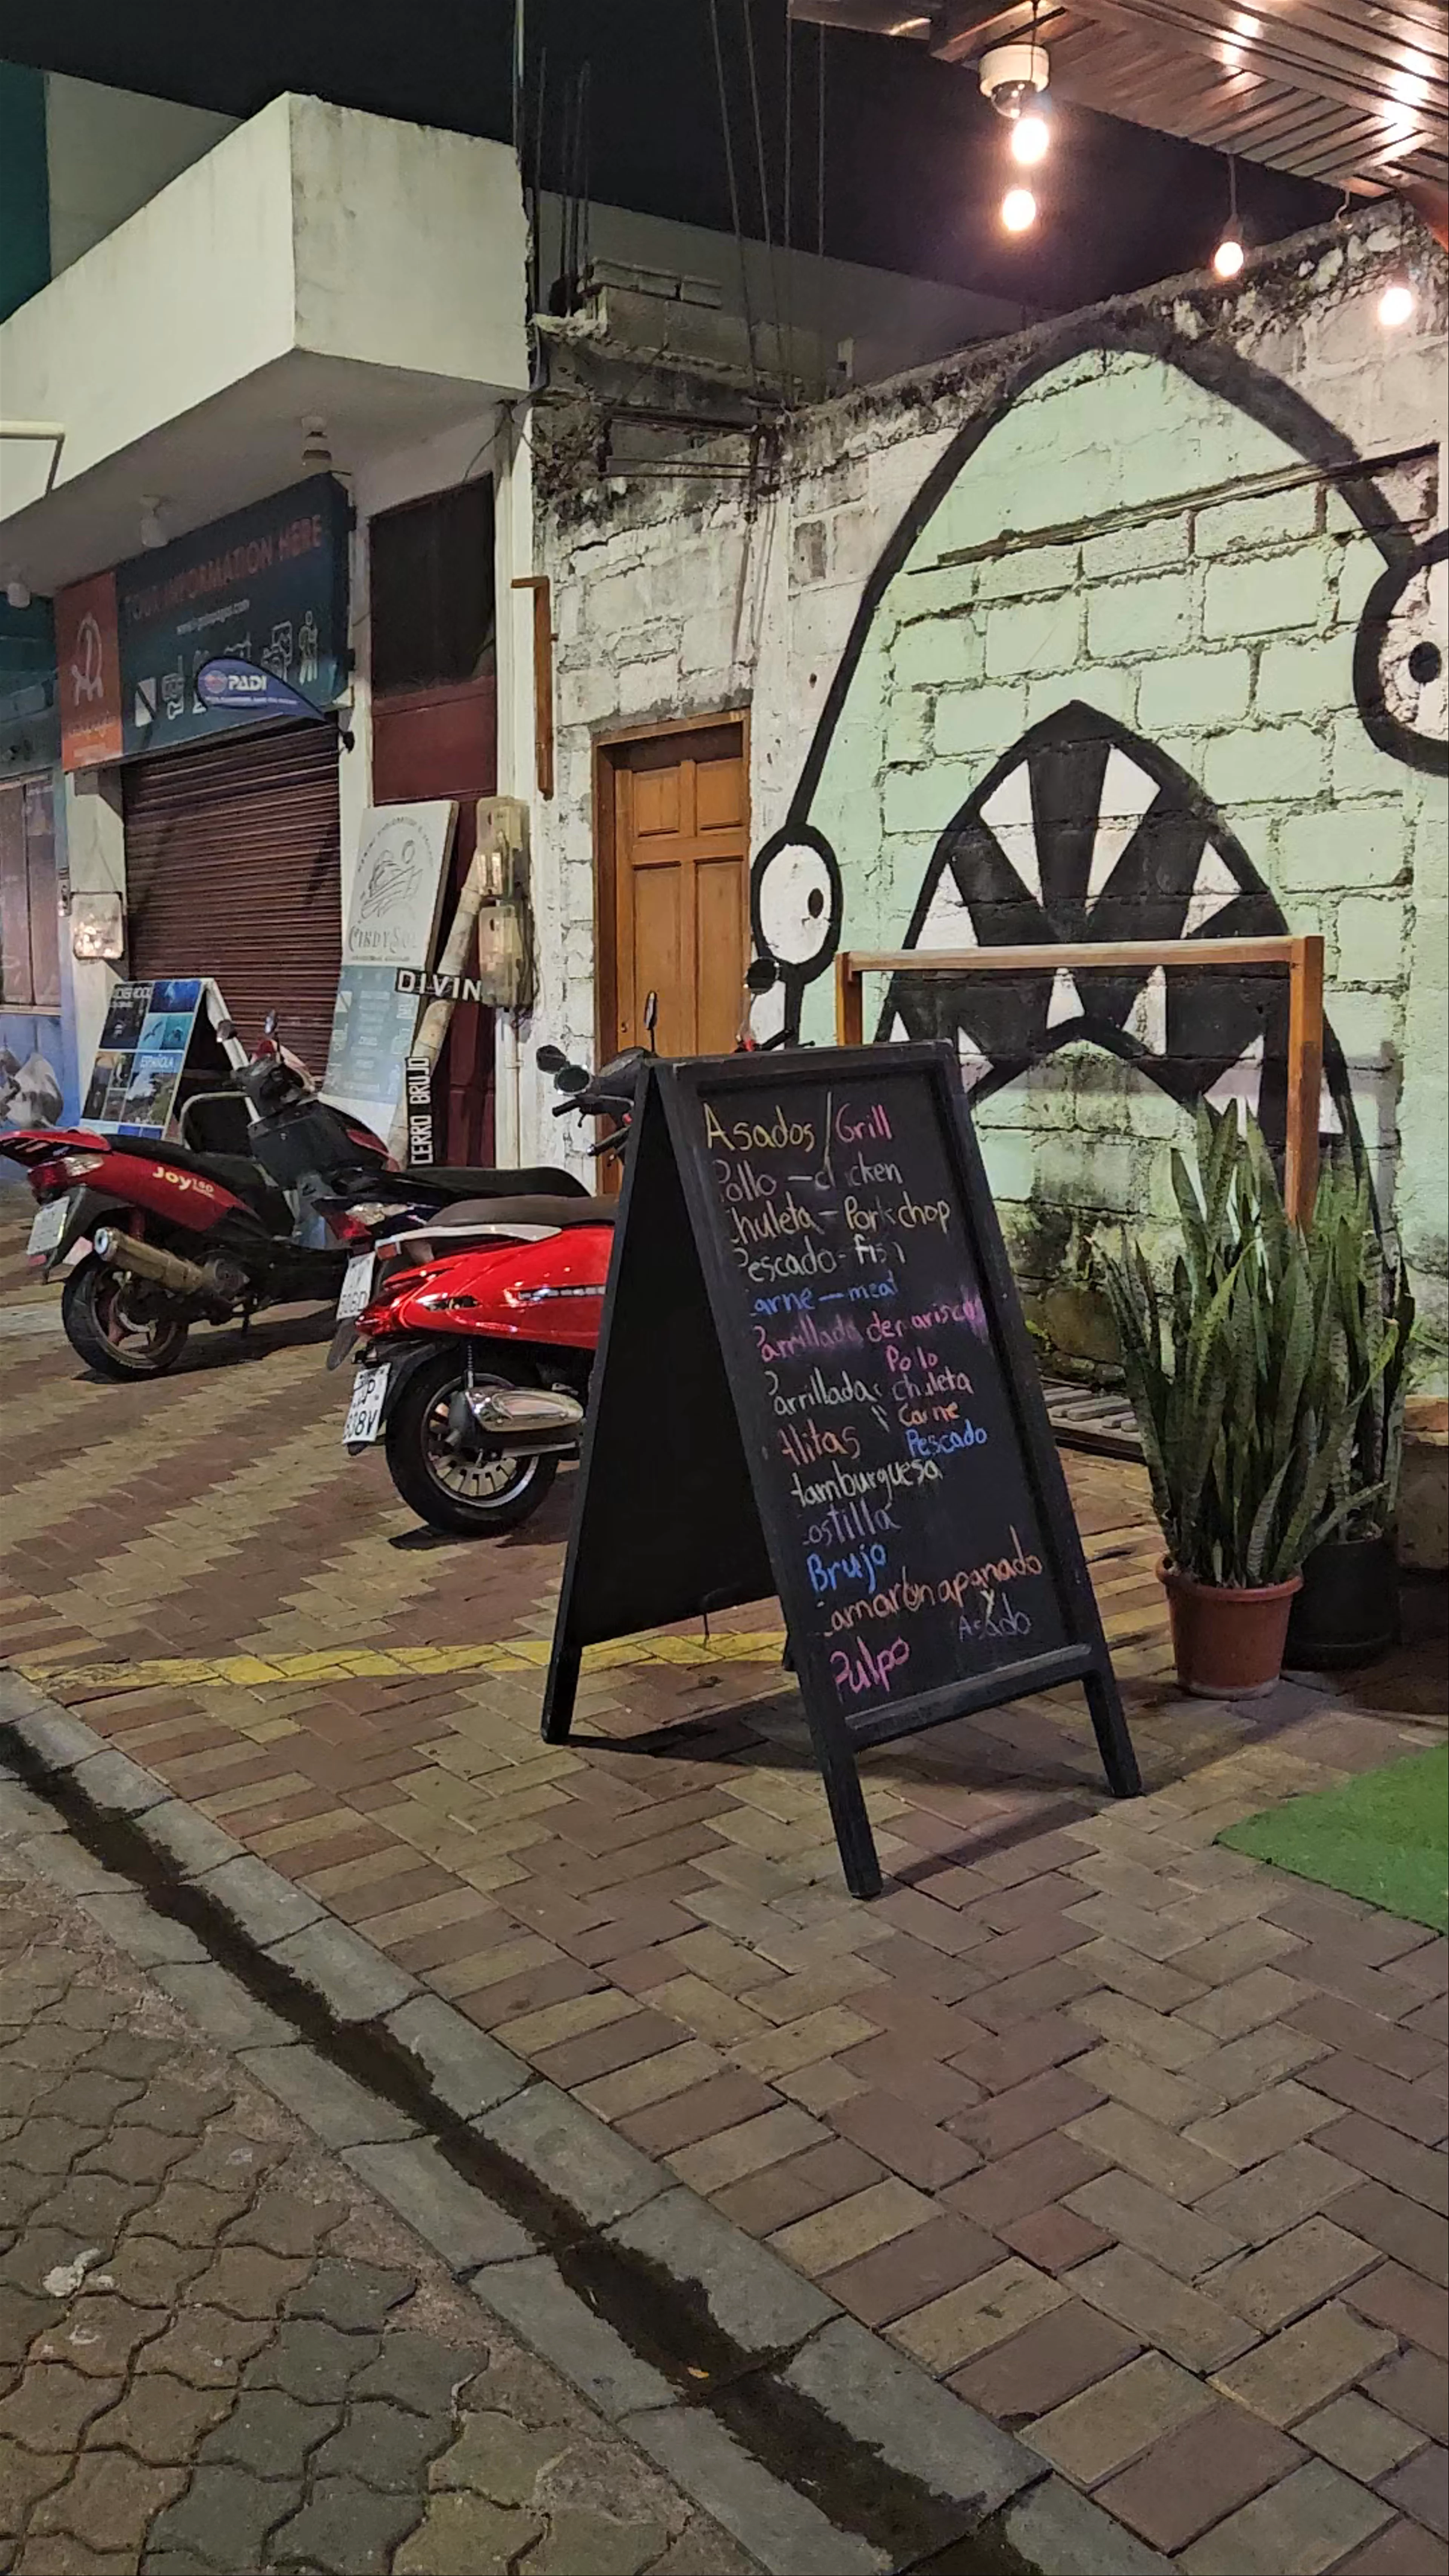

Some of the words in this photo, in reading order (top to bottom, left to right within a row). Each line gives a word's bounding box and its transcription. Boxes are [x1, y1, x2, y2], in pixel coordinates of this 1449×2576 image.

[165, 536, 272, 606] INFORMATION
[279, 514, 322, 561] HERE
[229, 675, 267, 691] PADI
[408, 1057, 431, 1105] BRUJO
[410, 1115, 433, 1165] CERRO
[704, 1103, 814, 1152] Asados
[835, 1103, 892, 1143] Grill
[712, 1159, 777, 1203] Pollo
[728, 1191, 825, 1245] huleta
[746, 1287, 816, 1317] arne
[886, 1345, 938, 1372] Polo
[906, 1418, 988, 1458] Pescado
[802, 1497, 902, 1546] ostilla
[806, 1543, 887, 1594] Brujo
[831, 1635, 910, 1704] Pulpo
